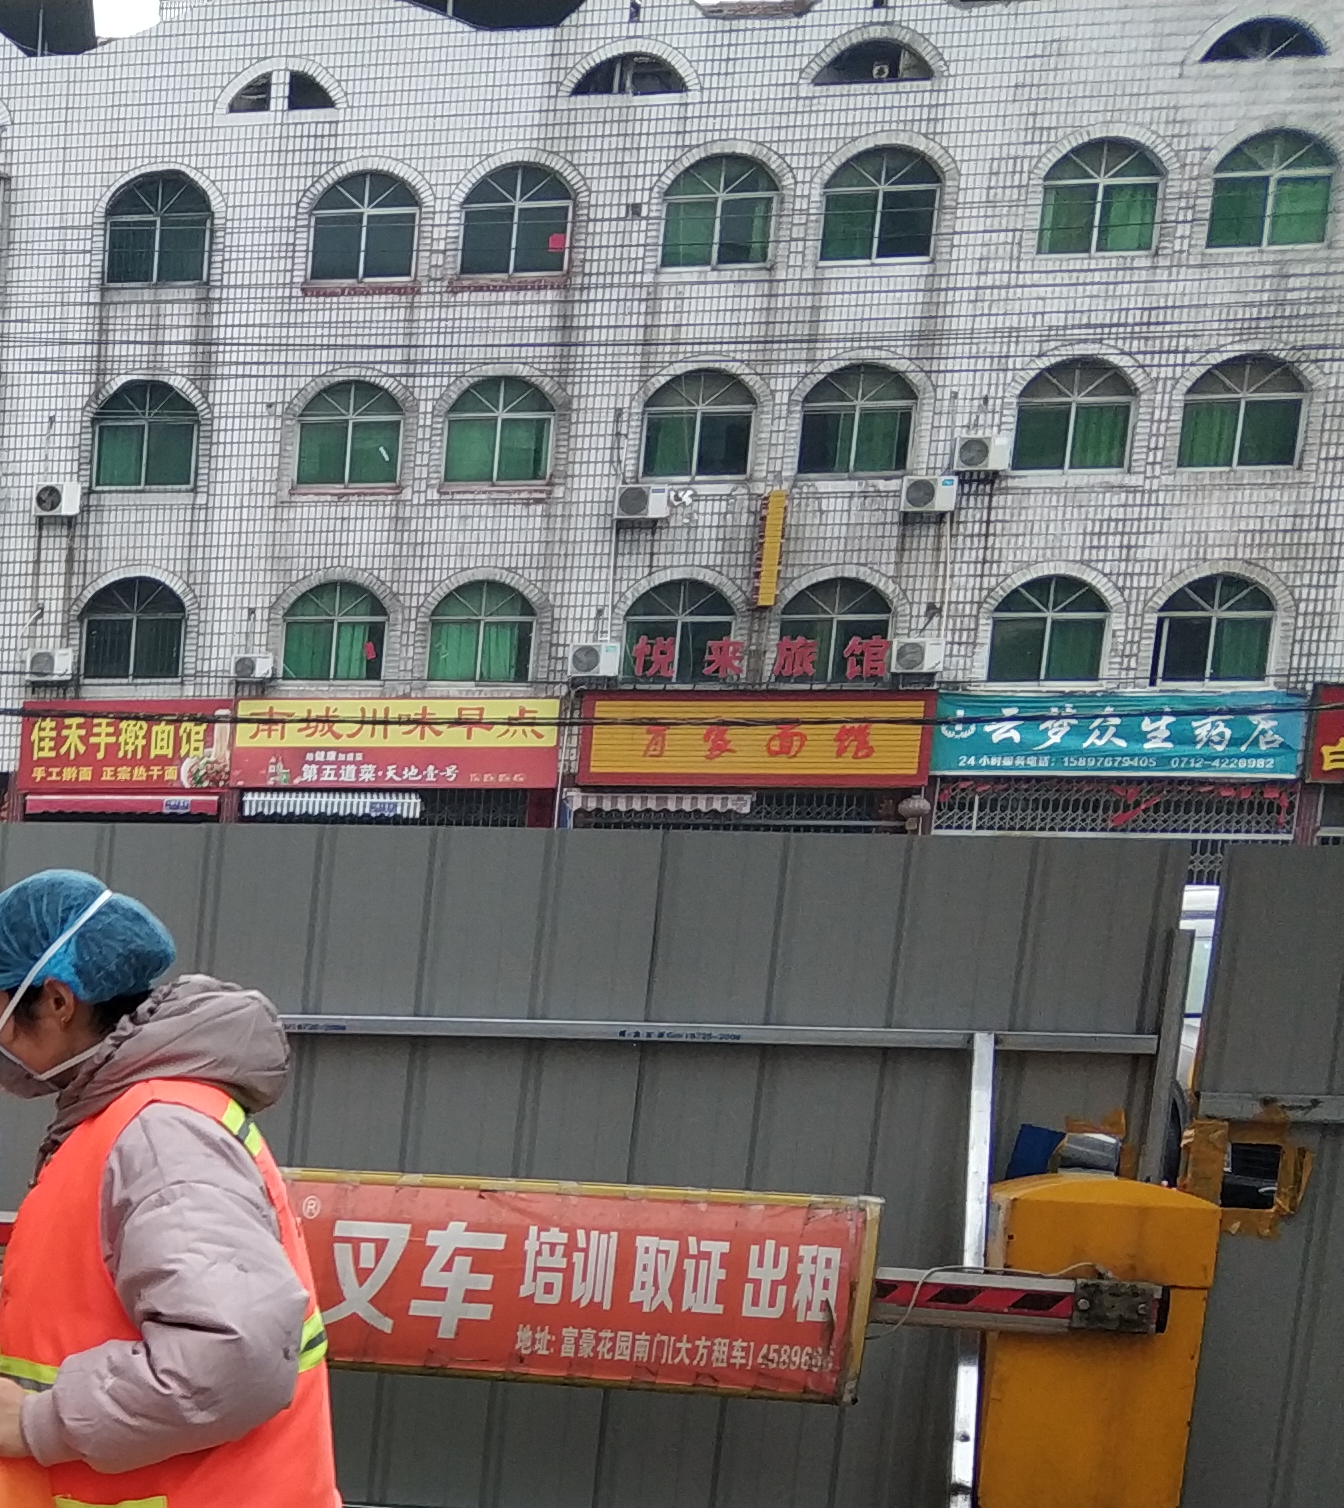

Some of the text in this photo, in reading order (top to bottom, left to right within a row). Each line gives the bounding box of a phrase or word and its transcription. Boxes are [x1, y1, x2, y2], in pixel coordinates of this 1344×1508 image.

[632, 635, 892, 679] 悦来旅馆
[318, 1219, 843, 1340] 叉车 培训 取证 出租
